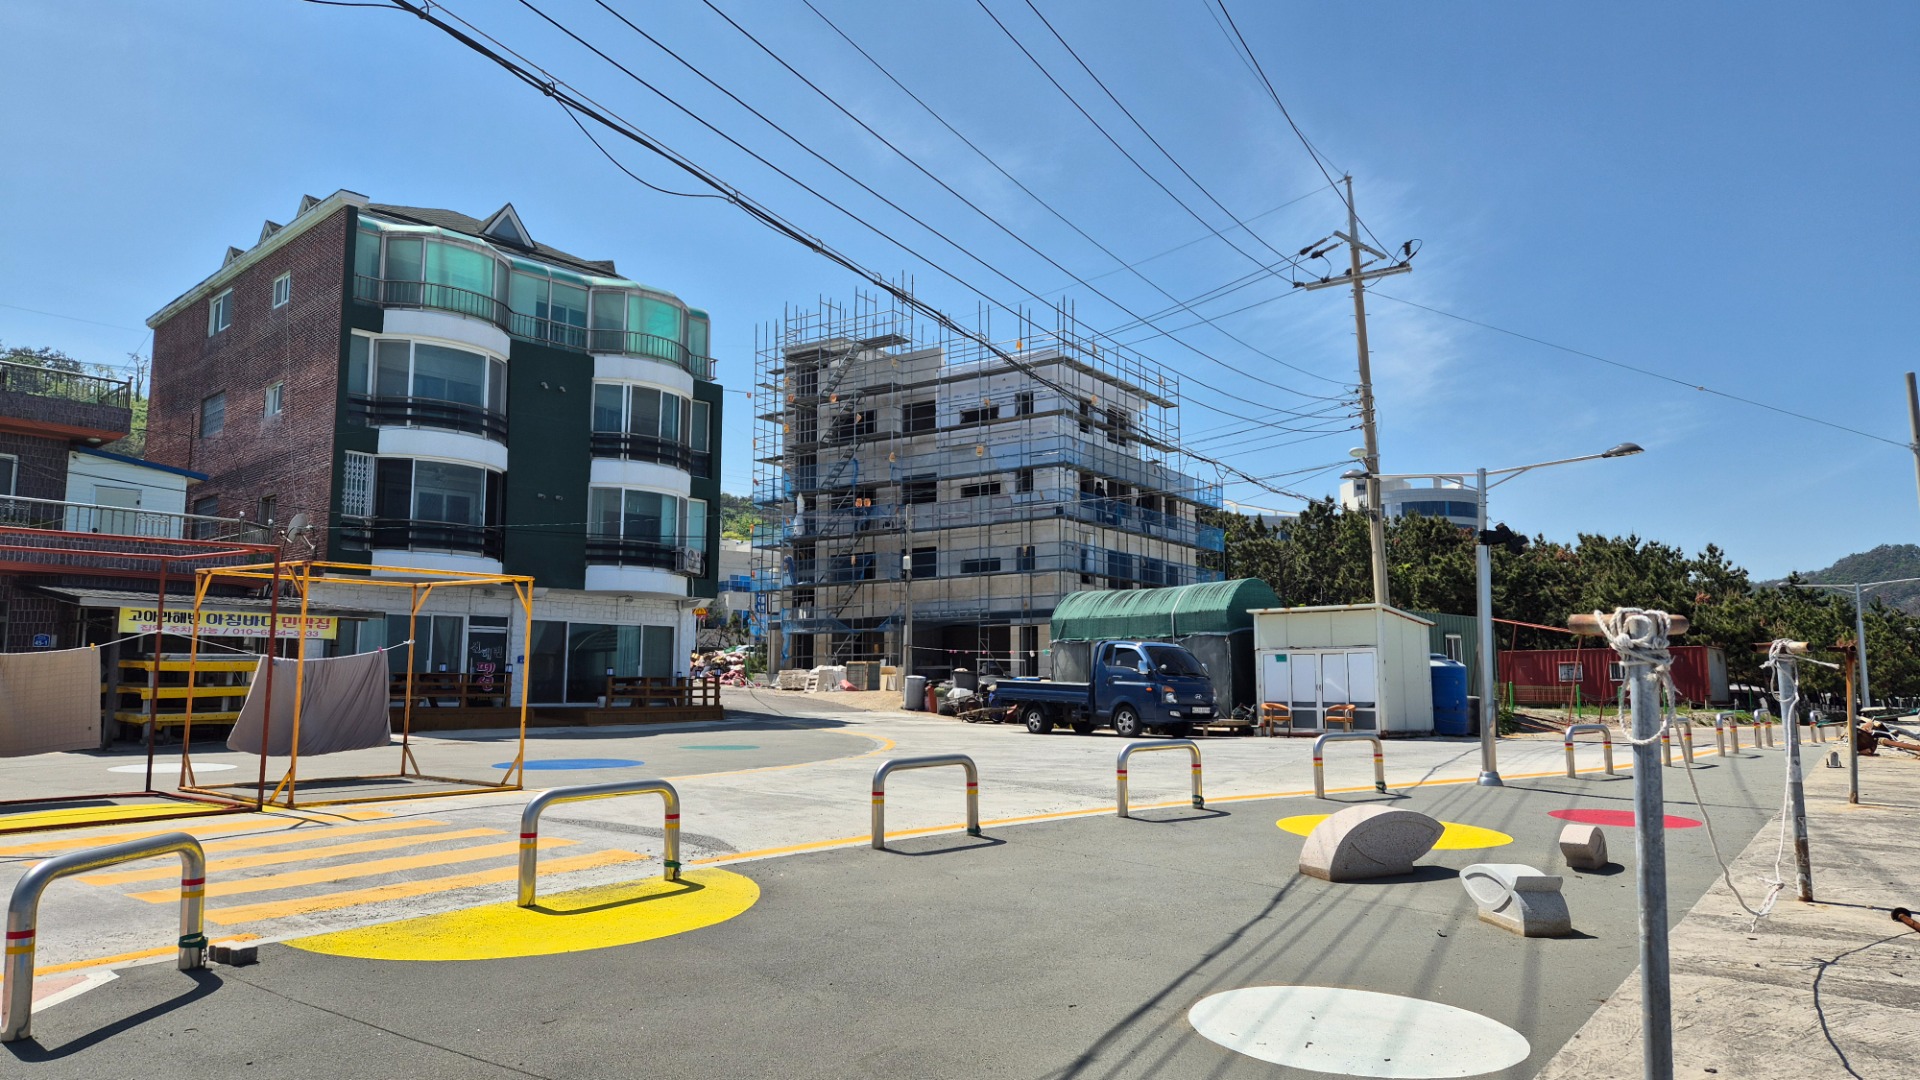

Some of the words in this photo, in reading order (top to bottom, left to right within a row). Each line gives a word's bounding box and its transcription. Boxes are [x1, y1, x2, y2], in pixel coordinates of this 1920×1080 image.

[206, 613, 278, 627] 아침바다
[282, 616, 331, 630] 민박집
[169, 625, 193, 633] 주차
[232, 628, 319, 637] 010-654-333
